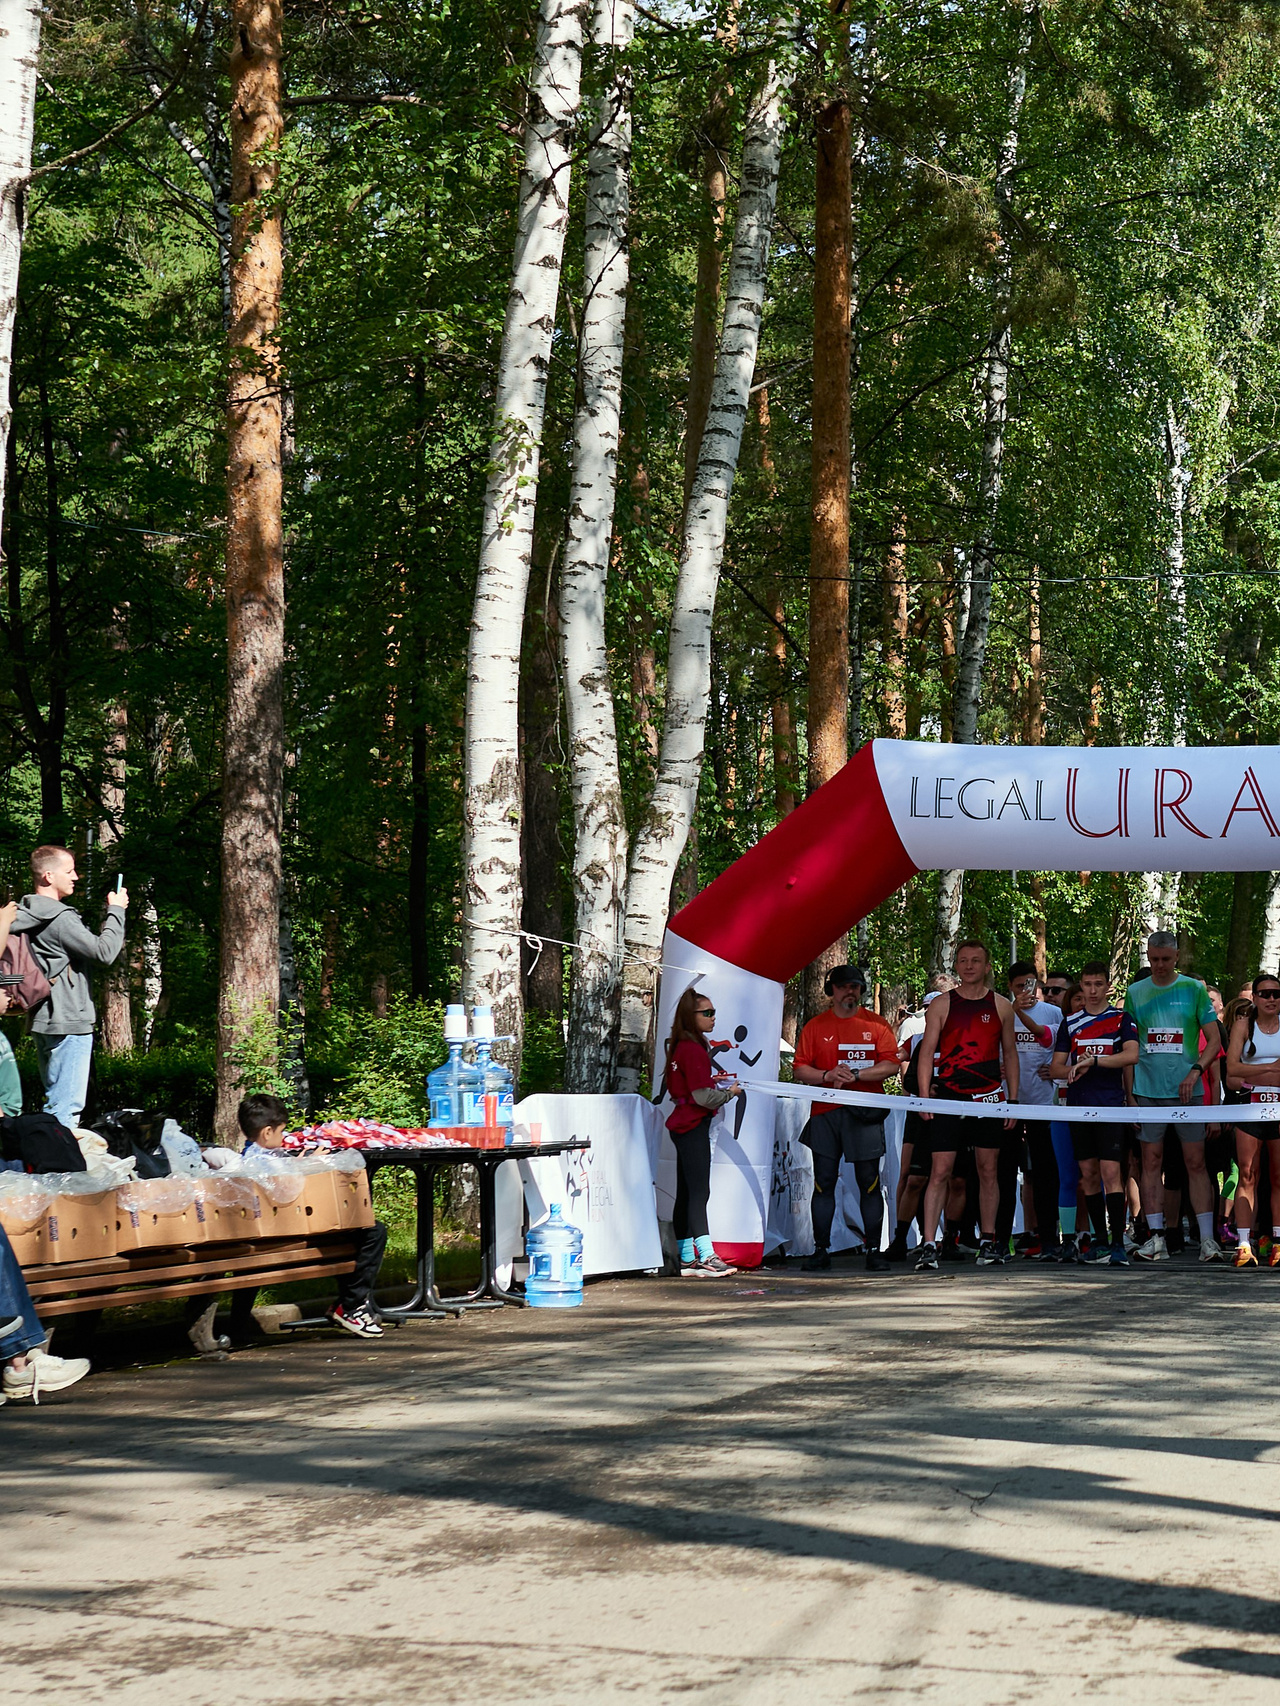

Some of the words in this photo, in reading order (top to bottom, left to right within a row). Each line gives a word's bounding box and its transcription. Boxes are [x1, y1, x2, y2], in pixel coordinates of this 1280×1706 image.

[909, 775, 1056, 821] LEGAL
[1017, 1033, 1035, 1042] 005
[1155, 1034, 1174, 1043] 047
[1085, 1045, 1104, 1054] 019
[847, 1051, 866, 1060] 043
[982, 1094, 1000, 1103] 098
[1259, 1093, 1279, 1102] 052
[592, 1186, 614, 1207] LEGAL
